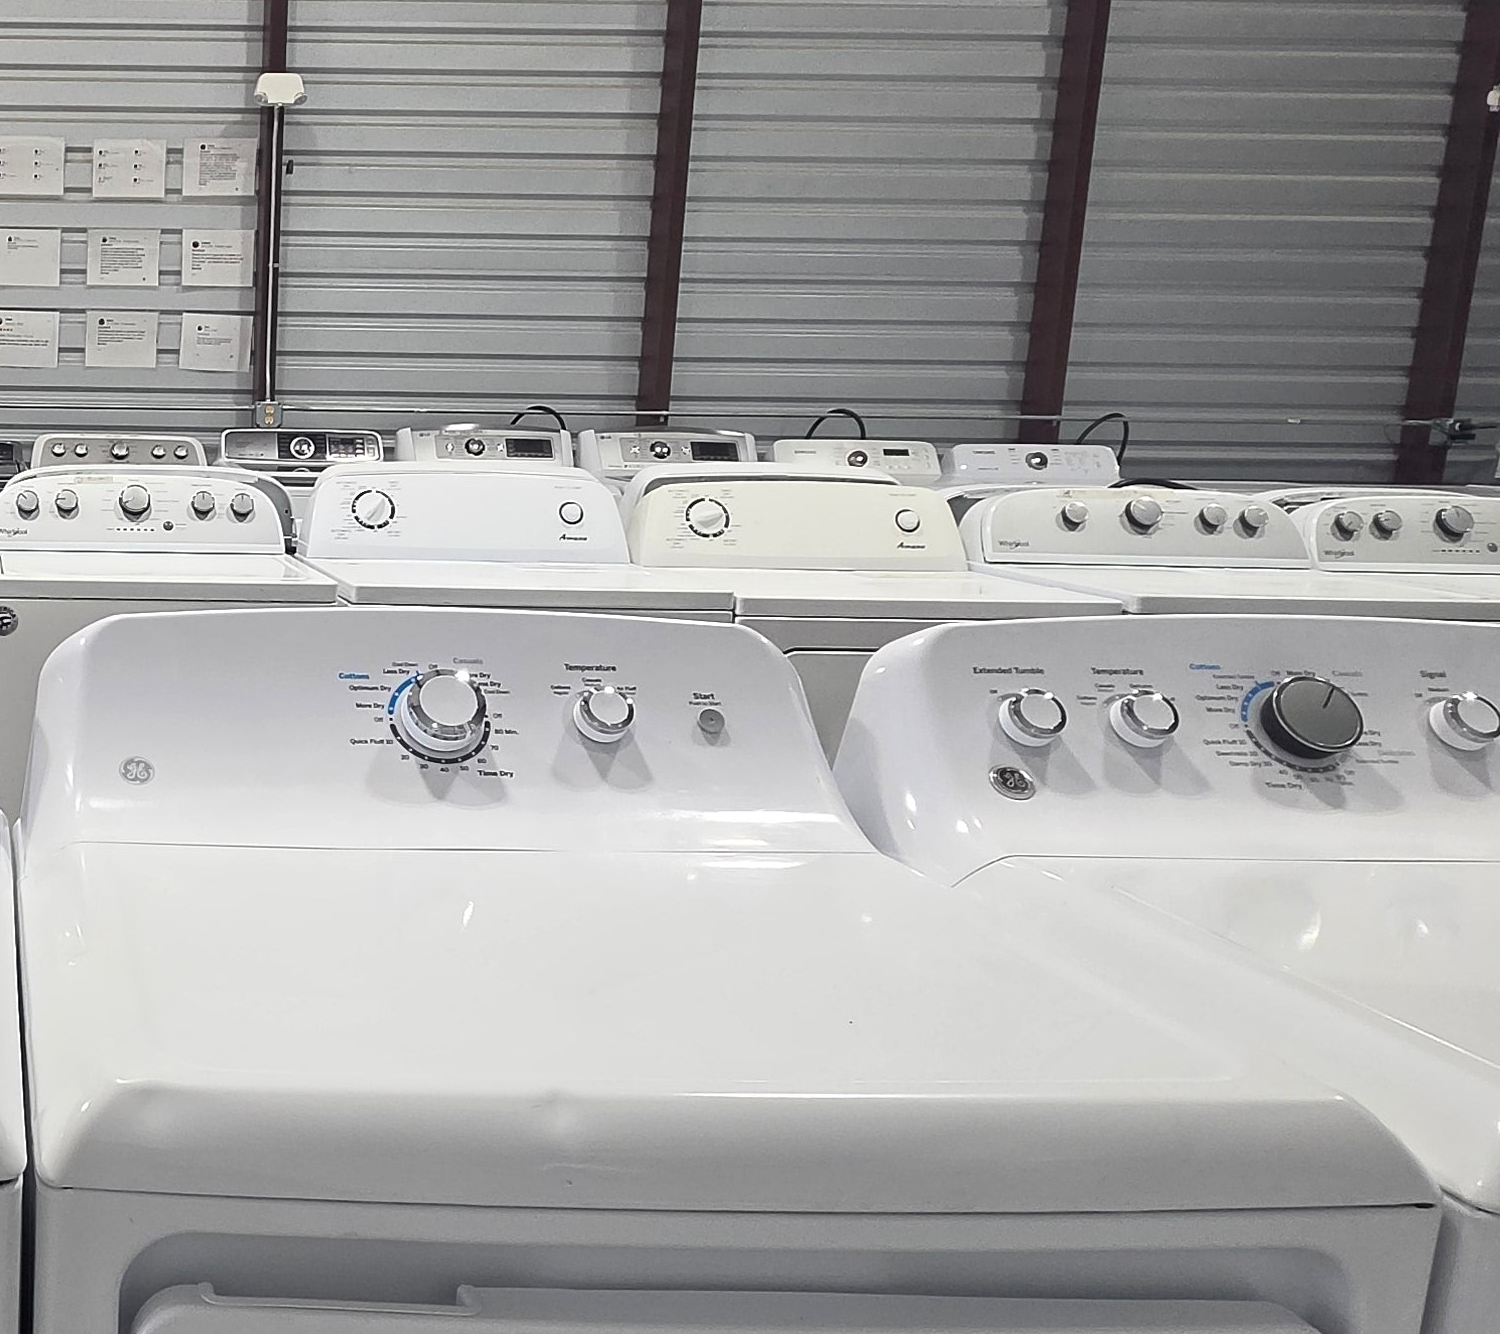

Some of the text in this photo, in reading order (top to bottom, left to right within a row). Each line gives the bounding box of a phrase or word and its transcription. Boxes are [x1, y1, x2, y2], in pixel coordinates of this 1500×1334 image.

[564, 663, 617, 672] Temperature
[1091, 667, 1144, 676] Temperature
[479, 671, 491, 679] Dry
[693, 692, 715, 700] Start
[499, 770, 514, 778] Dry
